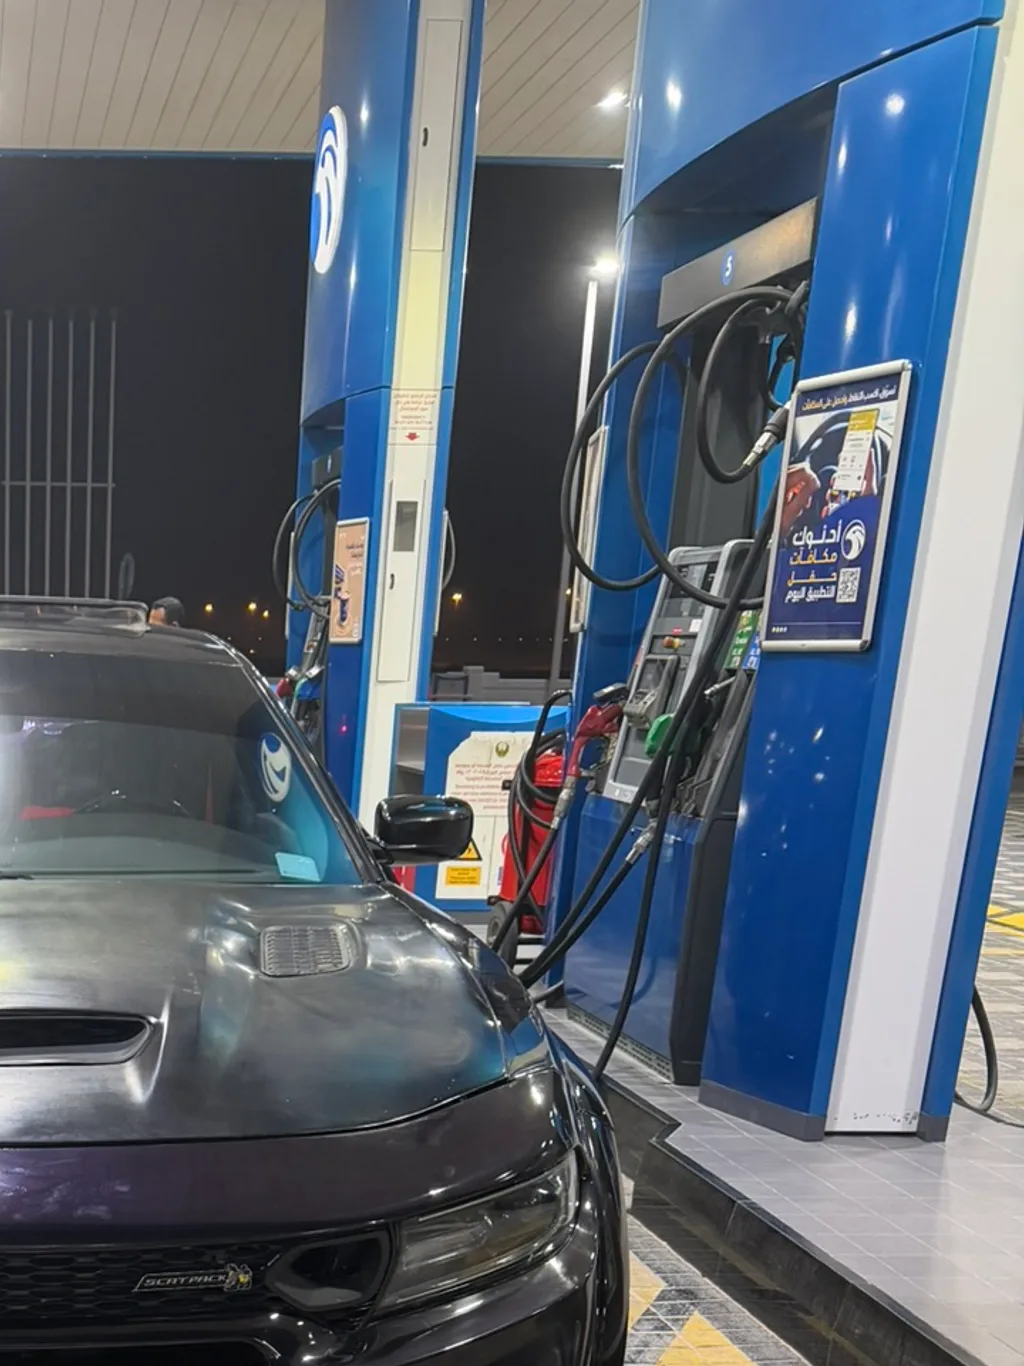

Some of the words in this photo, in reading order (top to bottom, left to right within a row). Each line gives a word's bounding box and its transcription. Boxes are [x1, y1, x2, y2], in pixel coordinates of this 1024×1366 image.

[792, 519, 842, 549] أدنوك
[784, 586, 807, 603] اليوم
[143, 1276, 188, 1287] SCAT
[188, 1274, 228, 1284] PACK
